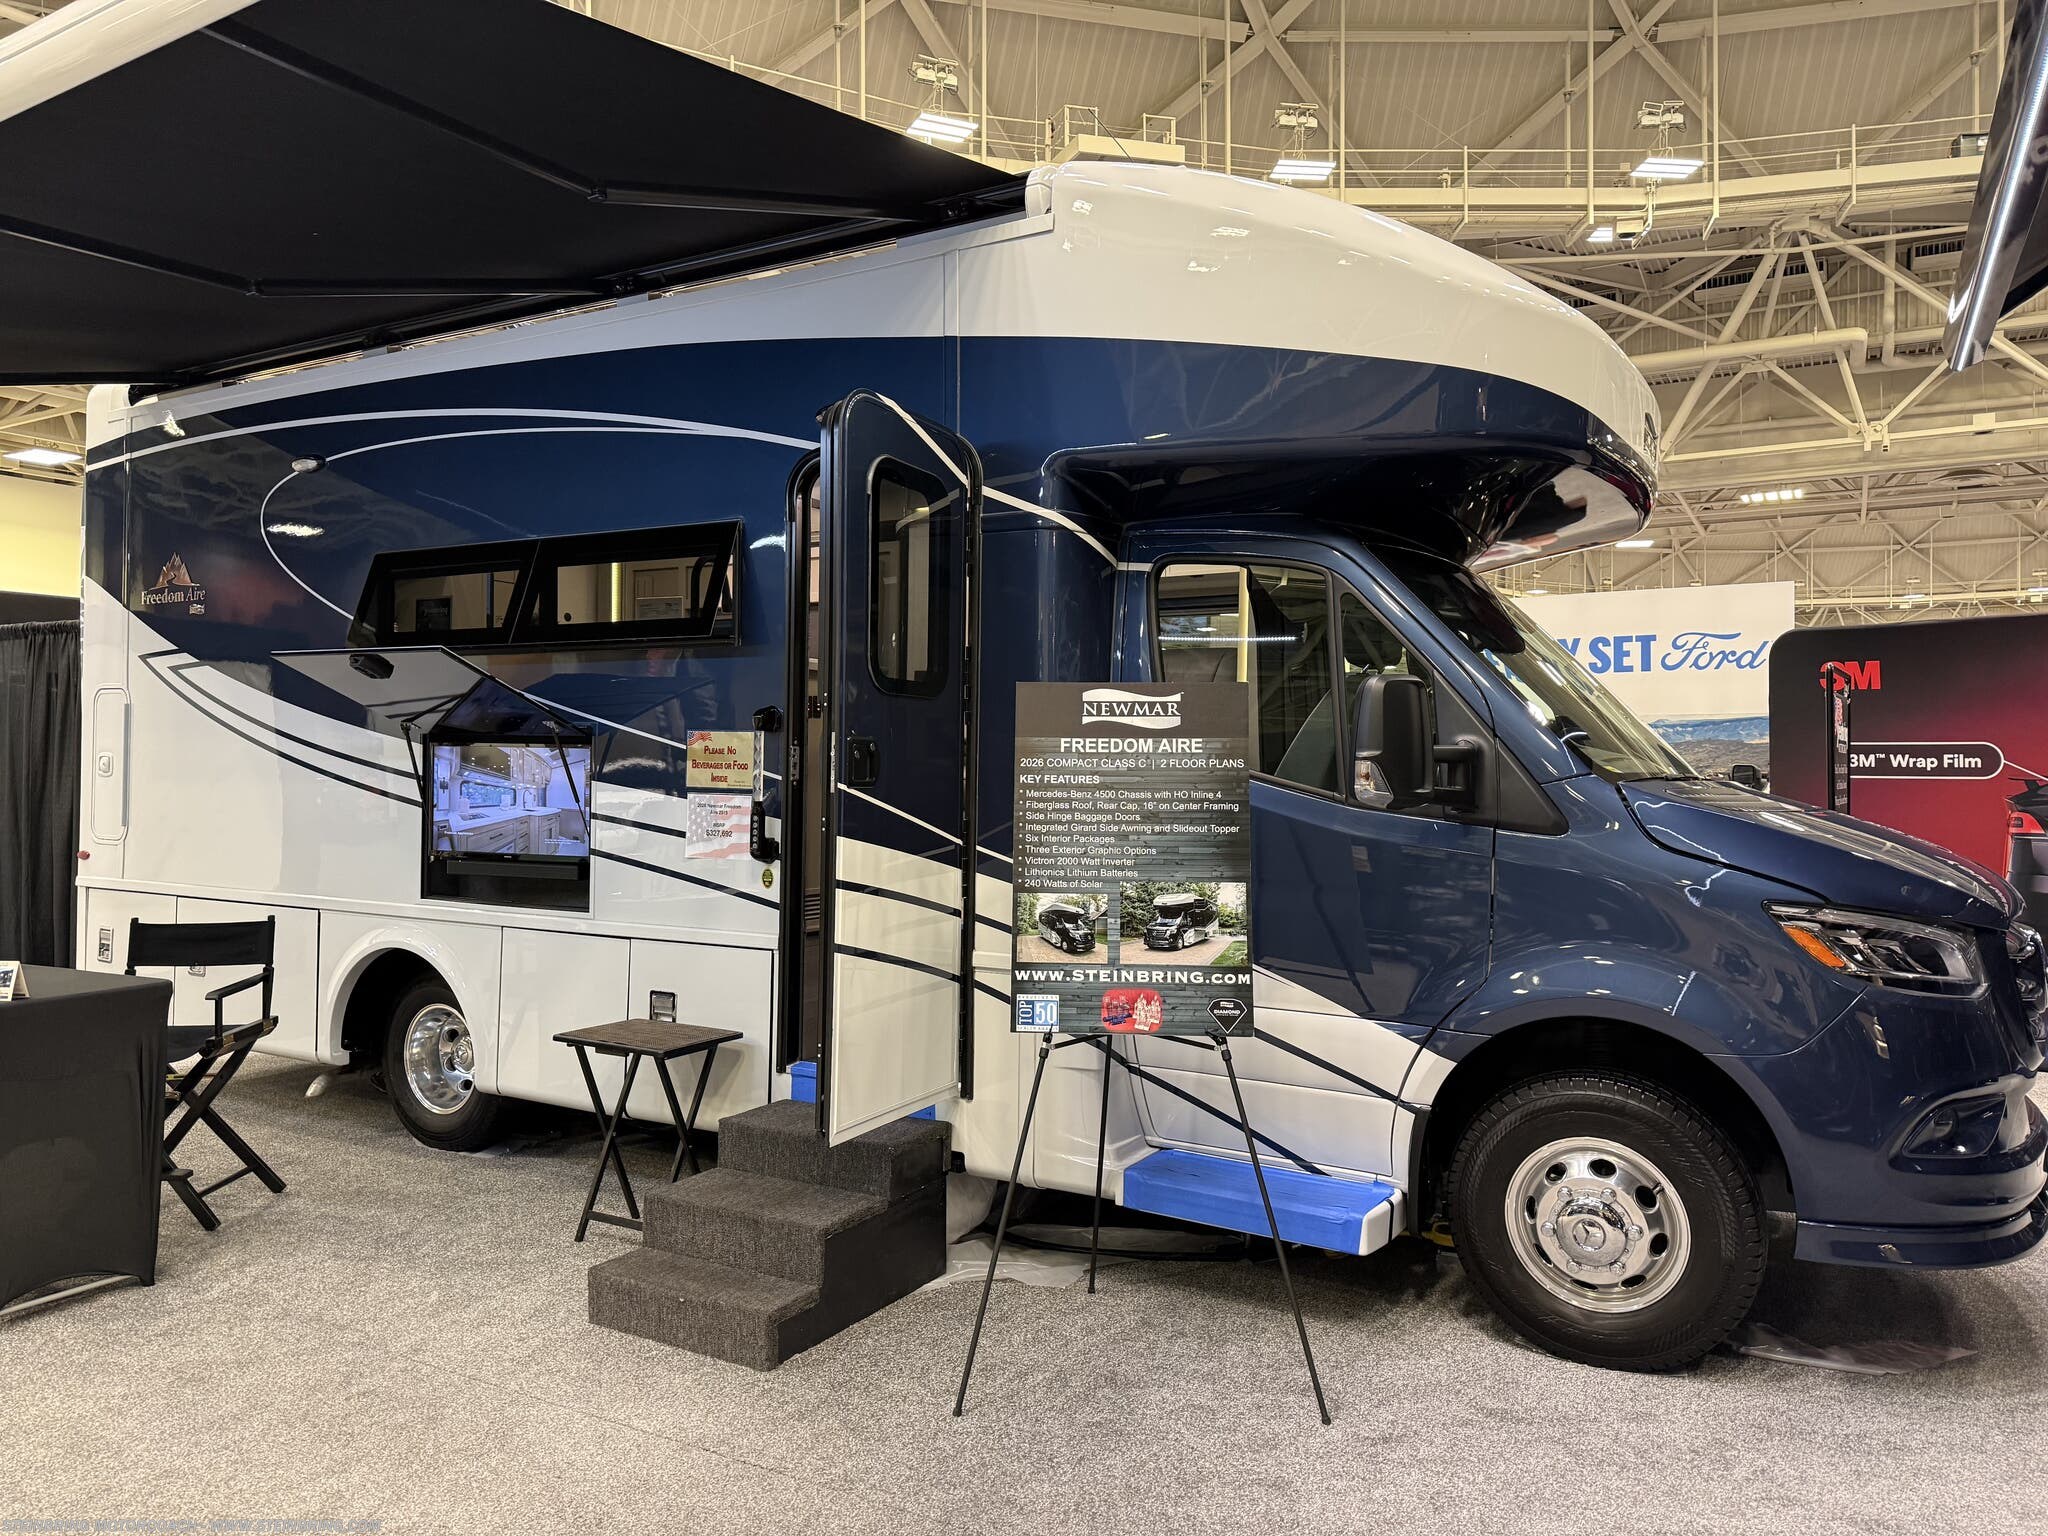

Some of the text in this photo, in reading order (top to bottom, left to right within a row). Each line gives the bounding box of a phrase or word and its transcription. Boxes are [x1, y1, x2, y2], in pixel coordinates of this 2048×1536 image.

[141, 587, 206, 605] Freedom Aire
[1588, 635, 1657, 674] SET
[1660, 632, 1770, 671] Ford
[1082, 702, 1181, 716] NEWMAR
[1060, 738, 1203, 753] FREEDOM AIRE
[1020, 758, 1044, 768] 2026
[1046, 758, 1098, 768] COMPACT
[1100, 759, 1136, 768] CLASS
[1138, 759, 1147, 768] C
[1160, 759, 1167, 768] 2
[1170, 759, 1206, 768] FLOOR
[1209, 759, 1245, 768] PLANS
[1890, 754, 1938, 771] Wrap
[1943, 754, 1982, 768] Film
[1020, 774, 1100, 784] KEY FEATURES
[1026, 790, 1222, 799] Mercedes-Benz 4500 Chassis with HO Inline 4
[1026, 801, 1070, 810] Fiberglass
[1072, 802, 1094, 810] Roof,
[1097, 802, 1118, 810] Rear
[1120, 802, 1140, 811] Cap,
[1172, 802, 1201, 810] Center
[1203, 802, 1240, 812] Framing
[1026, 812, 1044, 820] Side
[1047, 812, 1072, 822] Hinge
[1074, 812, 1112, 822] Baggage
[706, 830, 732, 838] $327,692
[1026, 823, 1240, 834] Integrated Girard Side Awning and Slideout Topper
[1026, 834, 1115, 844] Six Interior Packages
[1025, 844, 1157, 856] Three Exterior Graphic Options
[1025, 856, 1136, 866] Victron 2000 Watt Inverter
[1024, 868, 1138, 877] Lithionics Lithium Batteries
[1024, 879, 1103, 888] 240 Watts of Solar
[1014, 970, 1250, 984] WWW.STEINBRING.COM
[1018, 1001, 1058, 1024] TOP 50
